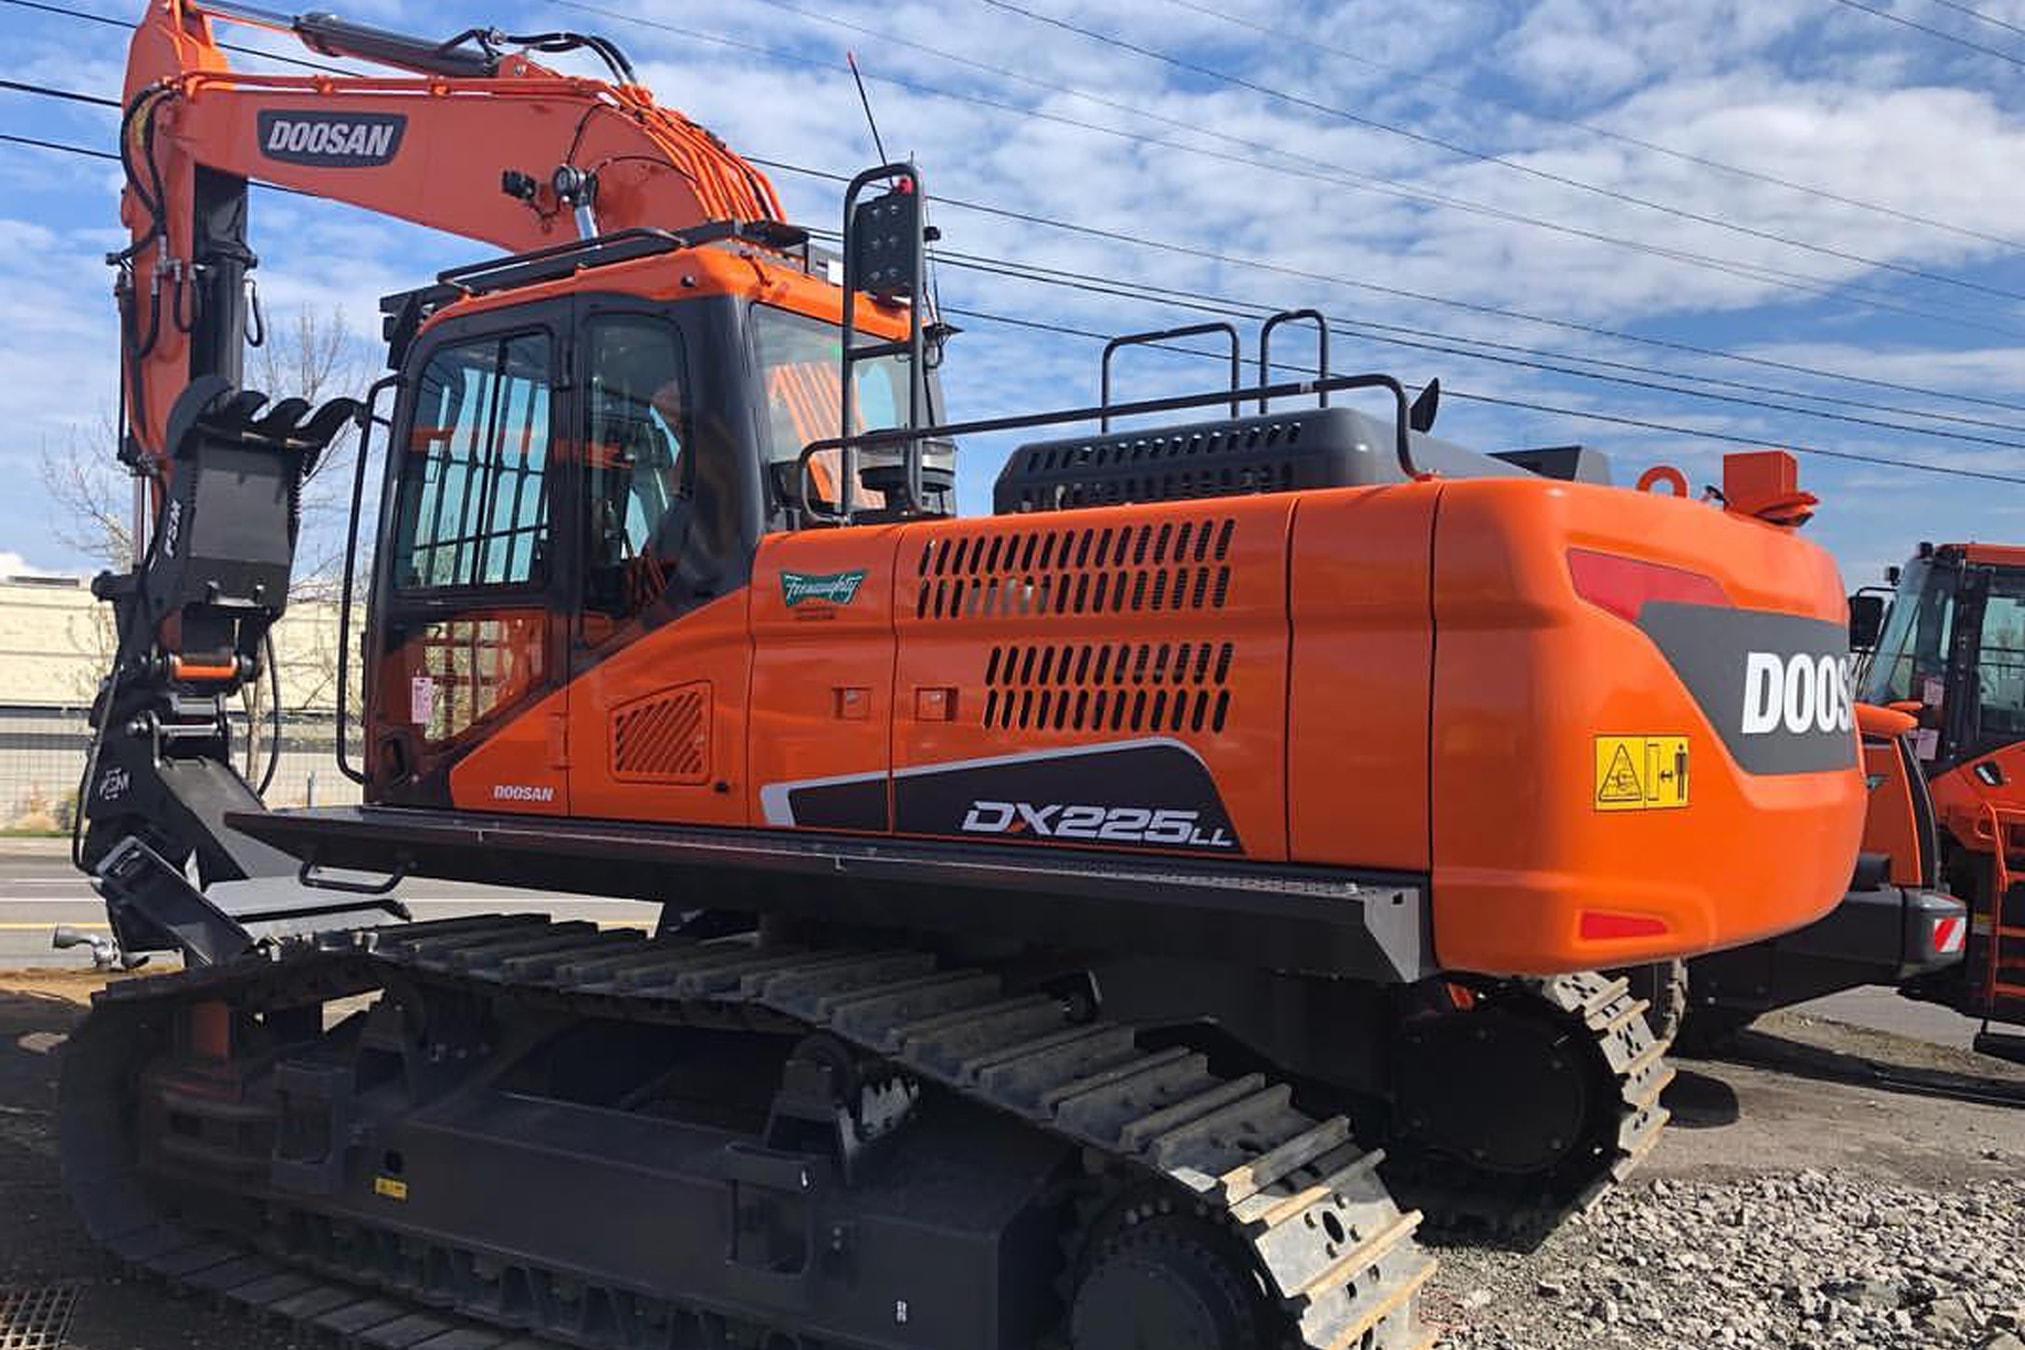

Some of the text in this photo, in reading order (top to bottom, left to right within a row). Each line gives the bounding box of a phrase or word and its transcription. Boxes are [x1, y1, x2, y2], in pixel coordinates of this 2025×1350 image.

[268, 120, 394, 156] DOOSAN
[1742, 651, 1853, 734] DOOS
[494, 785, 554, 802] DOOSAN
